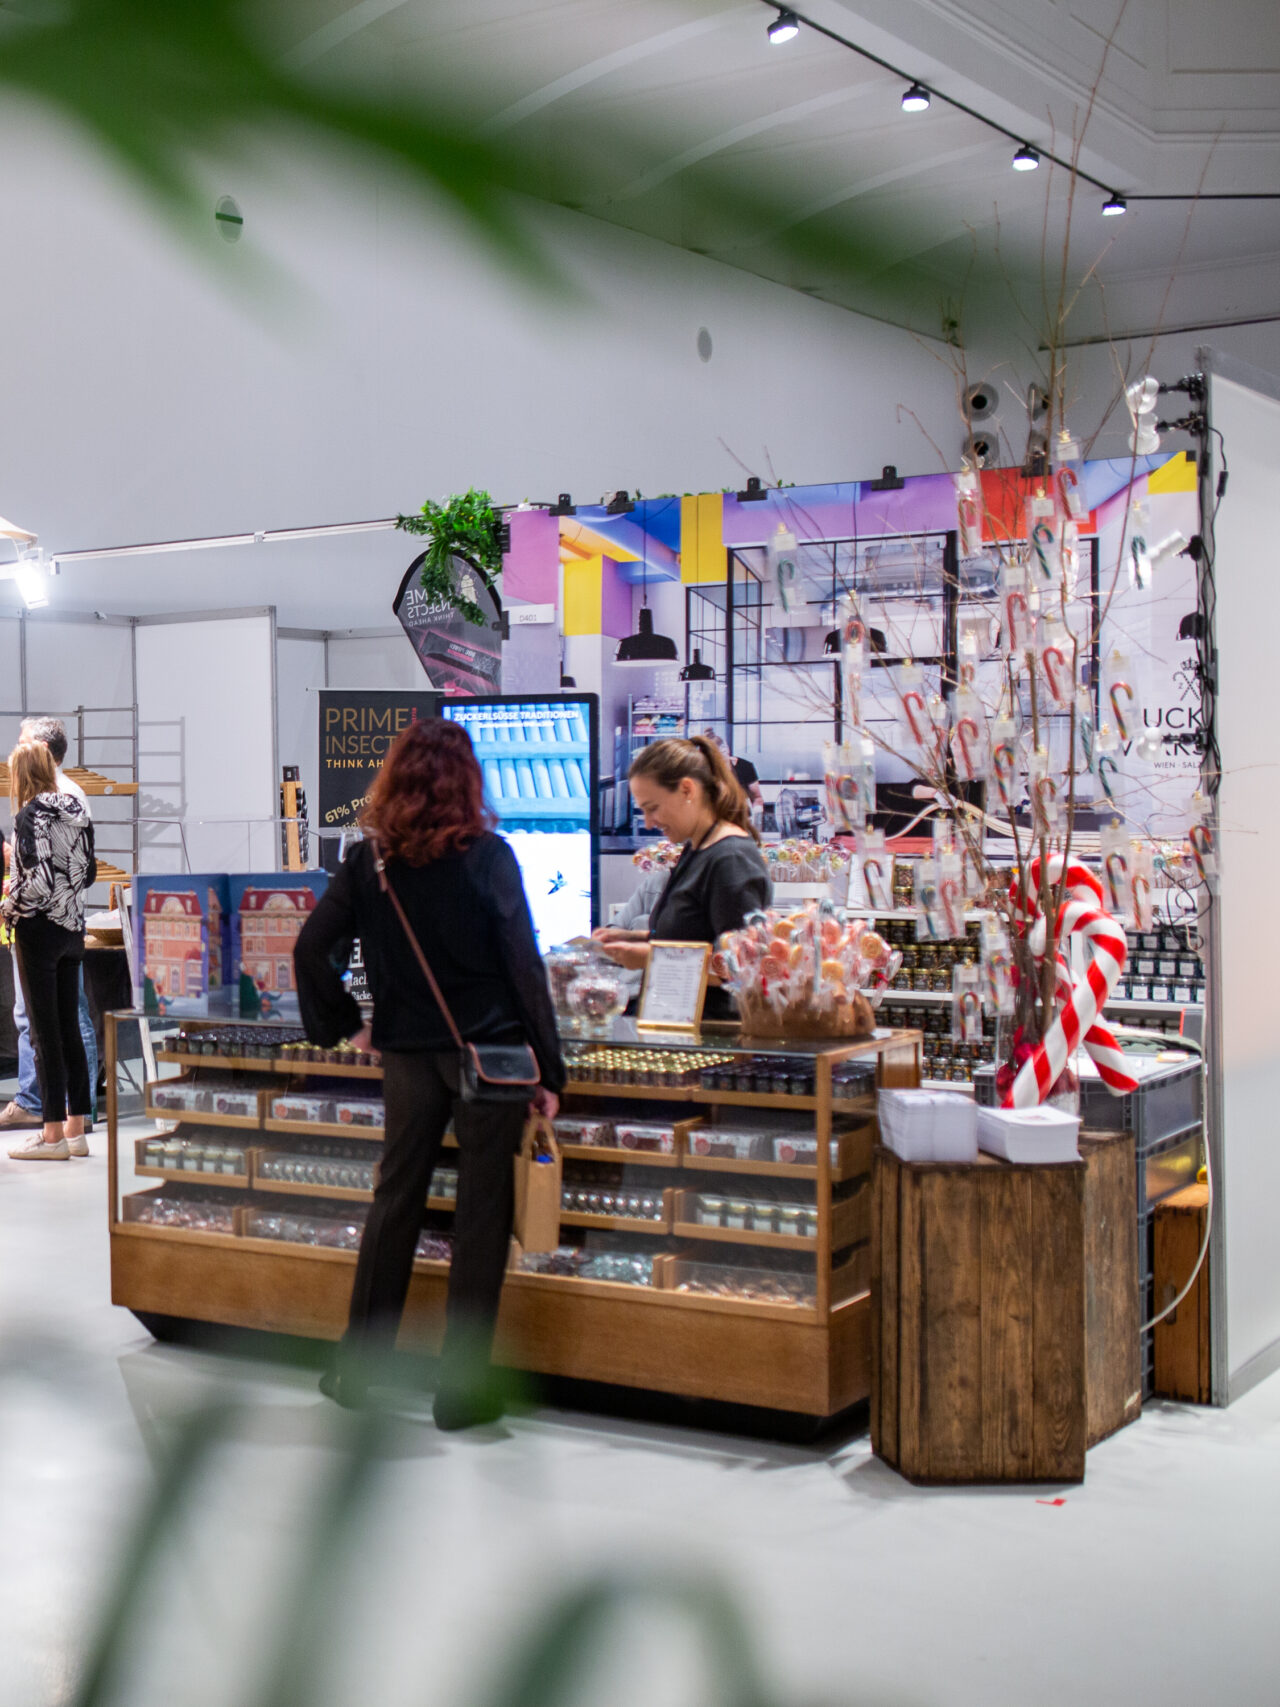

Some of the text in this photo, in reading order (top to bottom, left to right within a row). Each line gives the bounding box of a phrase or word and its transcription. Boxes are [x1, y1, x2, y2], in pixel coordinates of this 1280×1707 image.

[325, 707, 409, 732] PRIME
[520, 710, 579, 720] TRADITIONEN
[1143, 707, 1202, 729] UCK
[325, 736, 397, 754] INSECT
[326, 759, 384, 768] THINK AH
[325, 804, 350, 823] 61%
